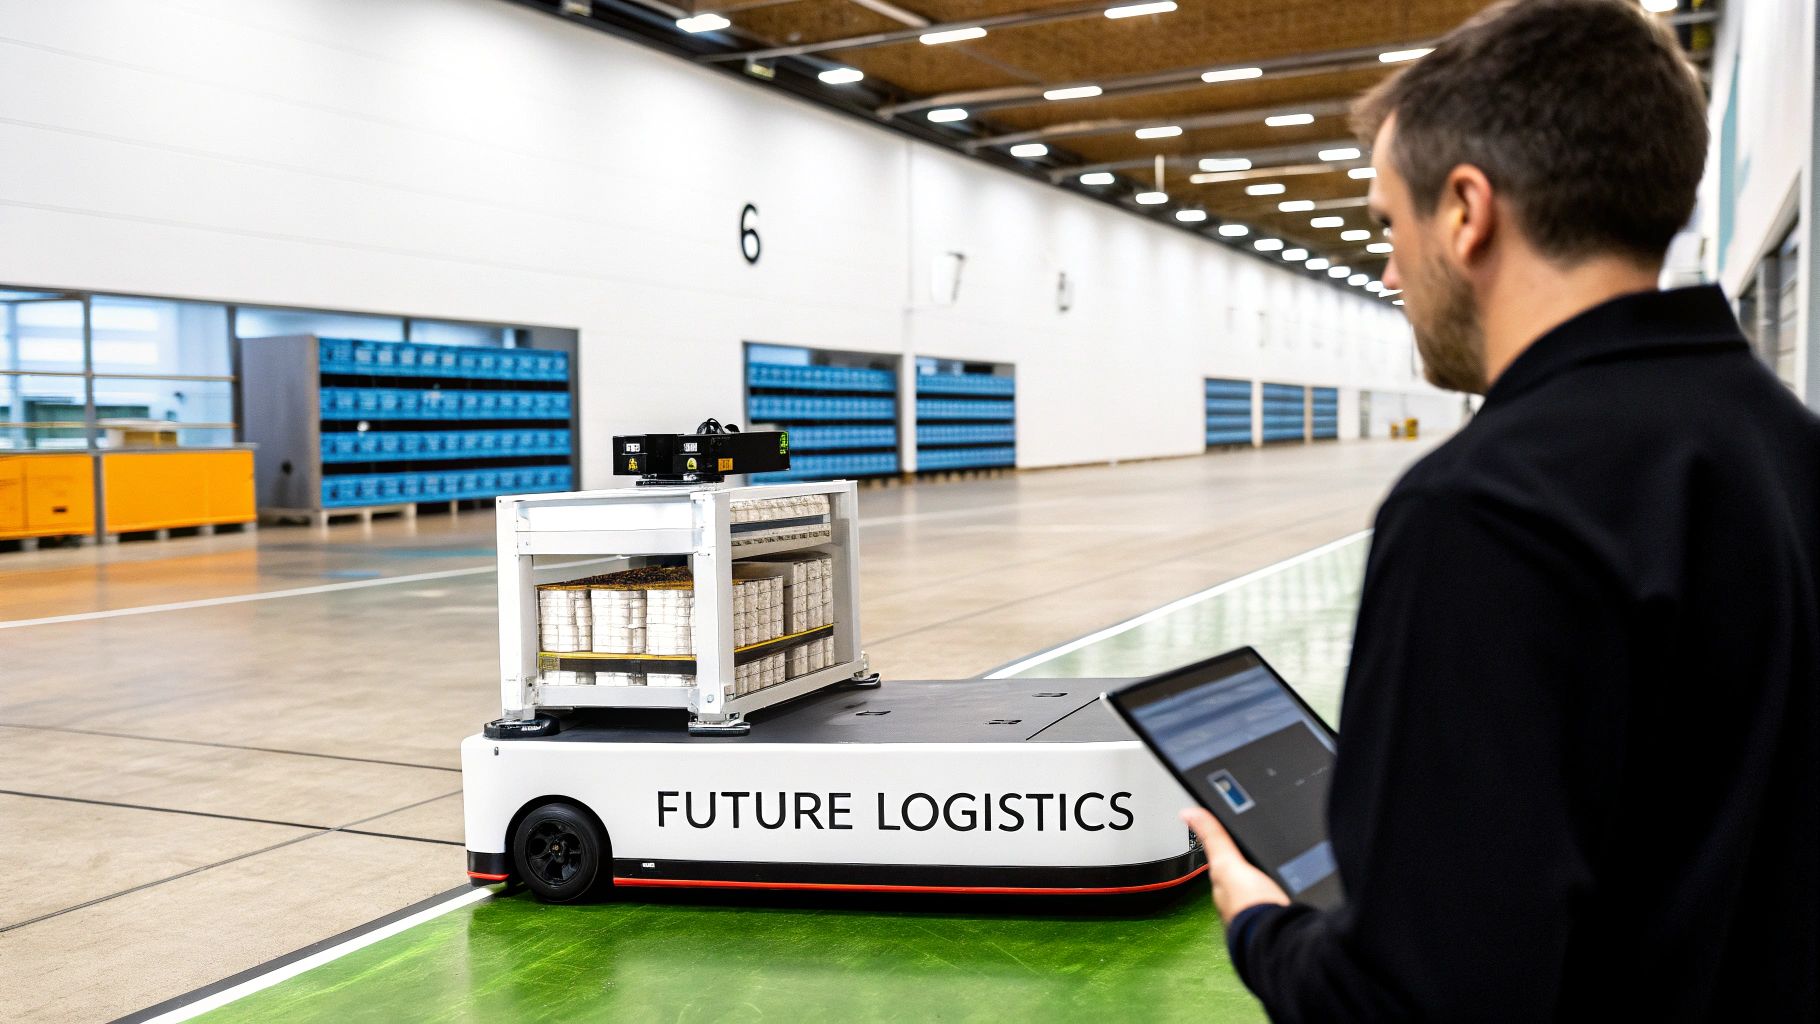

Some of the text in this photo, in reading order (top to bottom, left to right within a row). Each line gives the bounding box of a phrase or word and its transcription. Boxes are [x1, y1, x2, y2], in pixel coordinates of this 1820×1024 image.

[740, 203, 761, 265] 6
[657, 790, 1134, 833] FUTURE LOGISTICS
